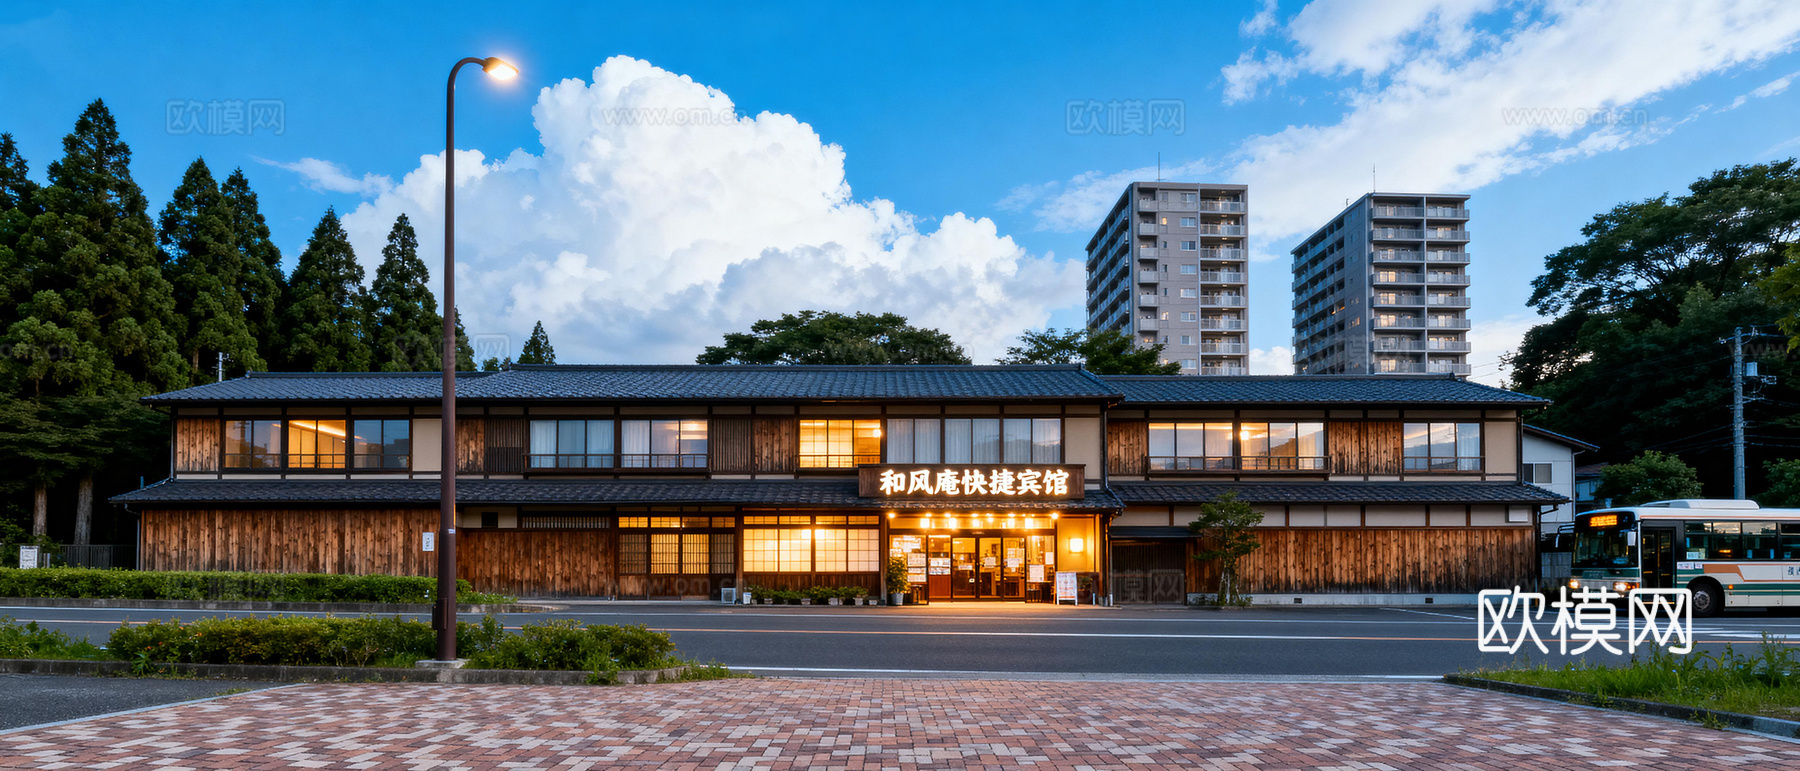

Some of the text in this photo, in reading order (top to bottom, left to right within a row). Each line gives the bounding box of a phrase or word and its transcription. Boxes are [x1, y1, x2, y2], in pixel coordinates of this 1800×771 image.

[879, 468, 1069, 495] 和风庵快捷宾馆
